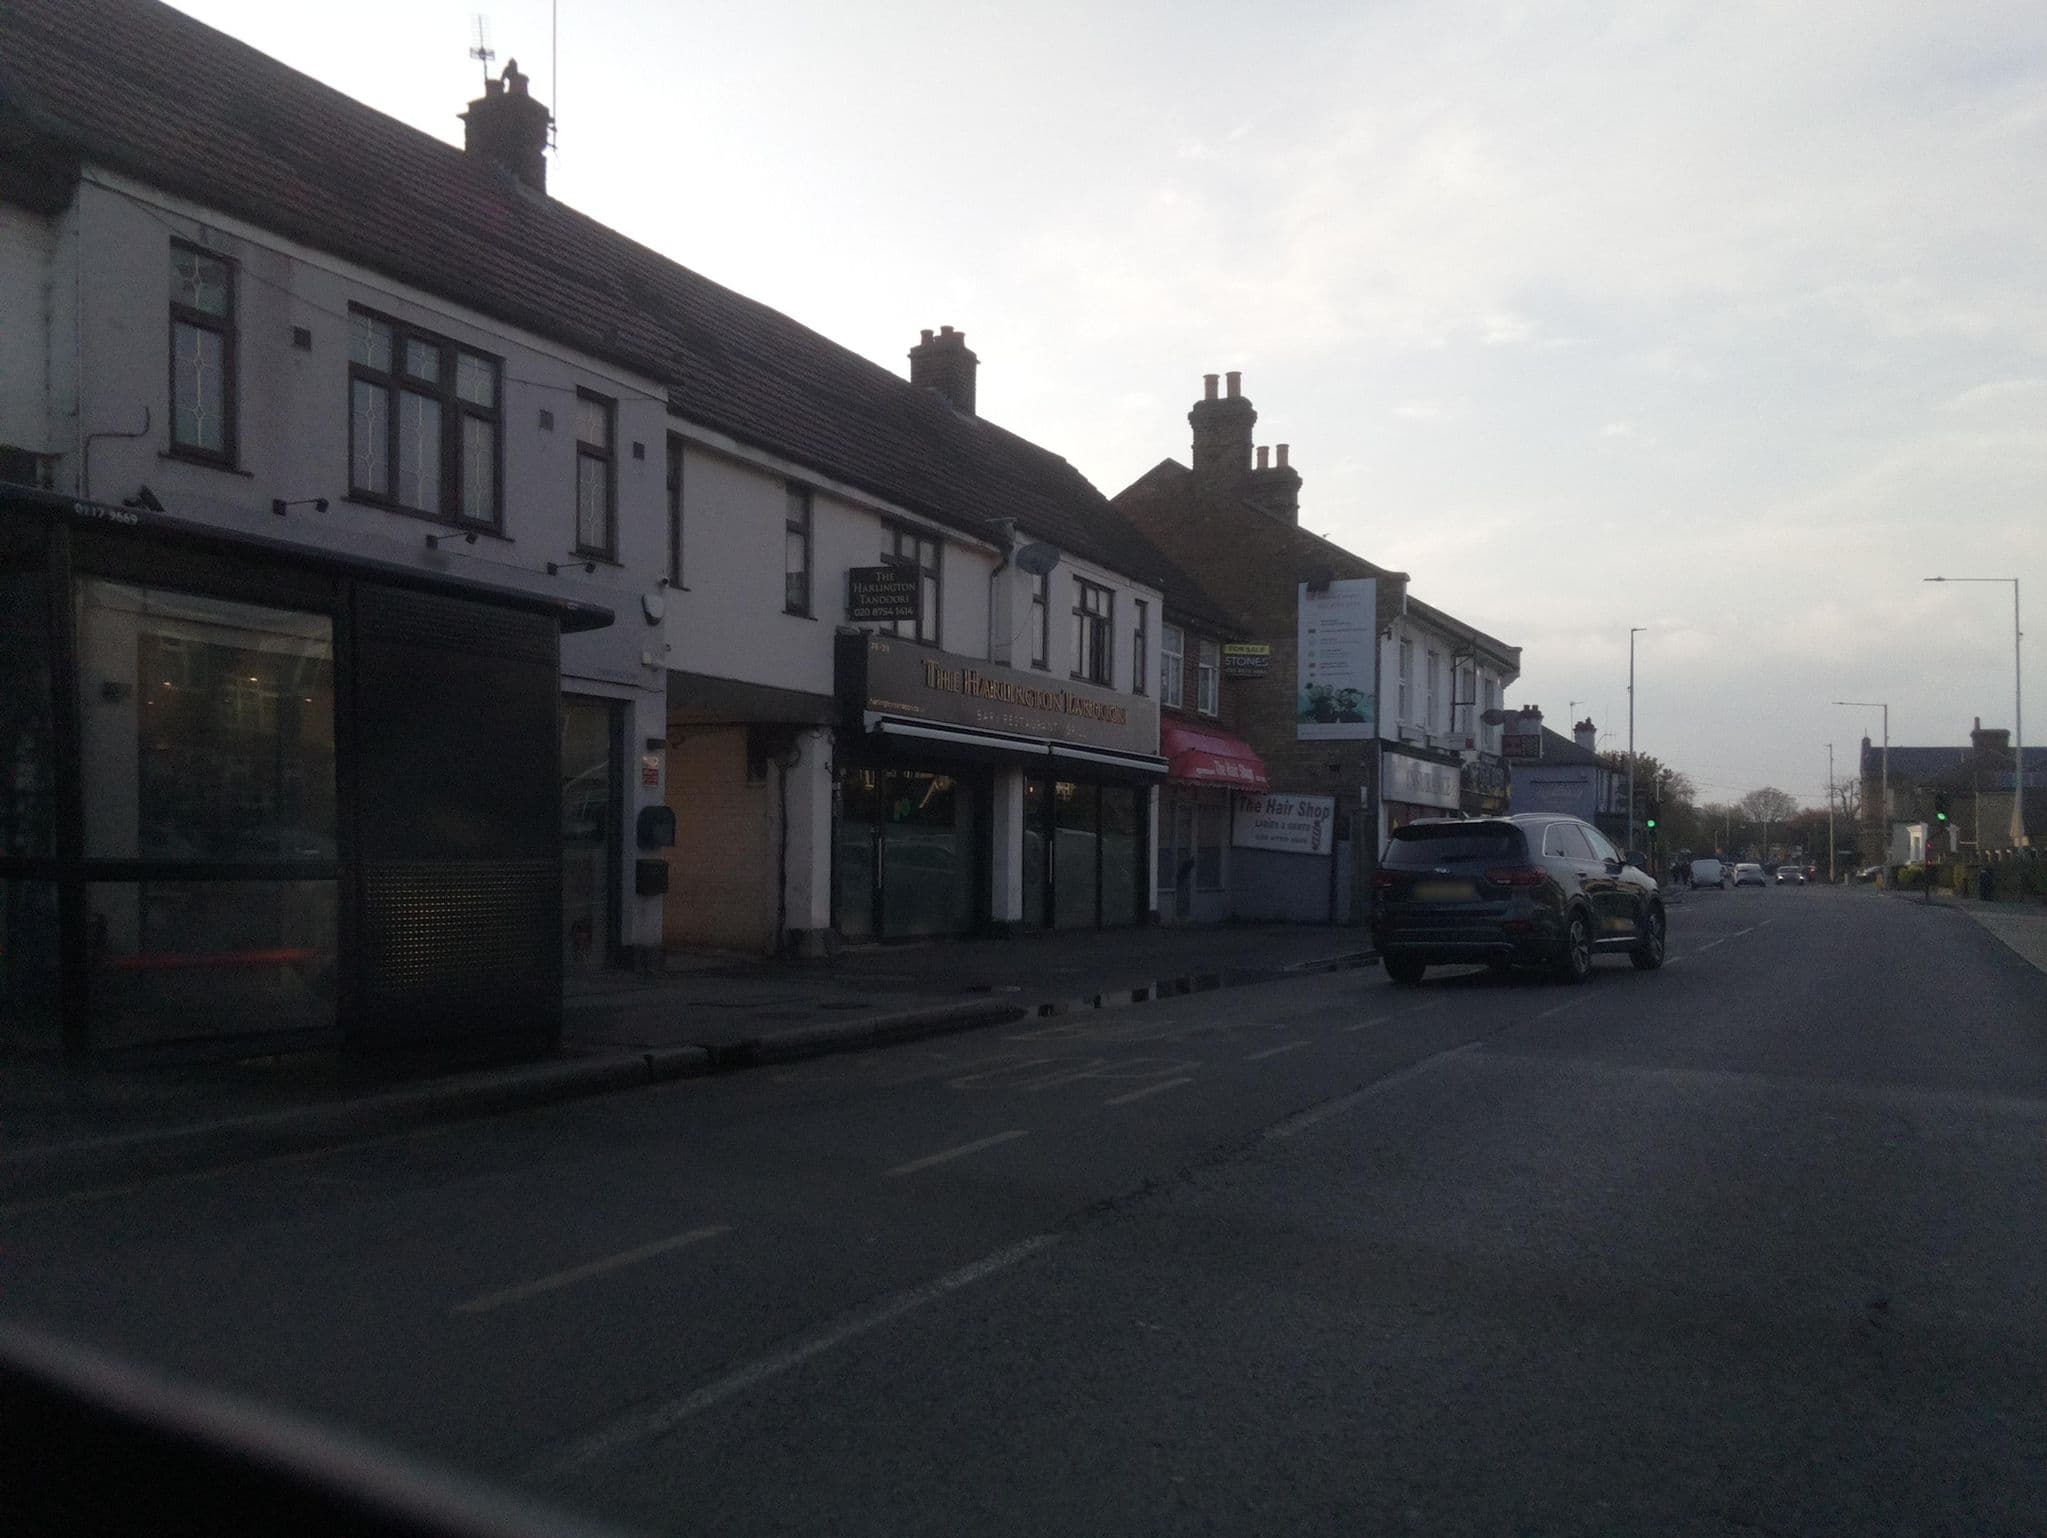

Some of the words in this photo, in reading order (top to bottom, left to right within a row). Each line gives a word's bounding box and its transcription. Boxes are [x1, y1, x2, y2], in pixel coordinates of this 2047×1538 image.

[853, 582, 916, 593] HARLINGTON
[854, 608, 871, 617] 020
[1225, 656, 1269, 667] STONES
[1239, 796, 1262, 813] The
[1266, 798, 1294, 816] Hair
[1298, 801, 1330, 821] Shop
